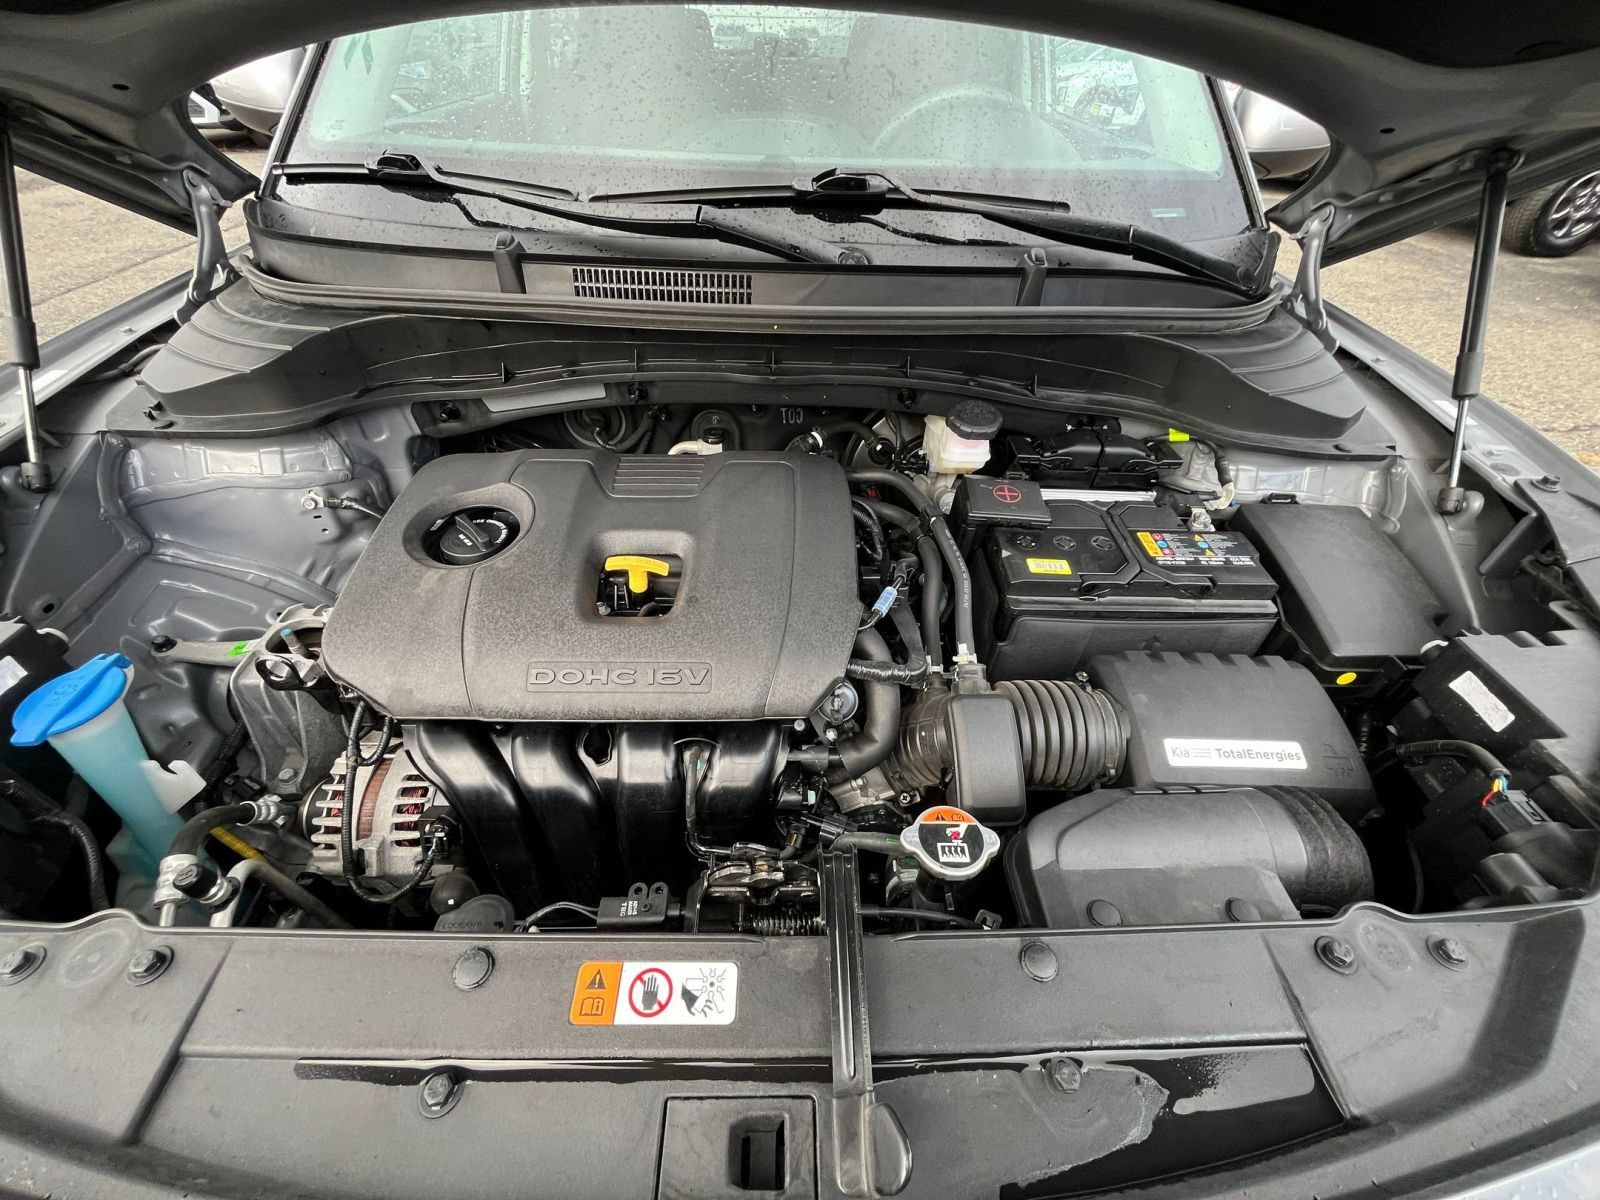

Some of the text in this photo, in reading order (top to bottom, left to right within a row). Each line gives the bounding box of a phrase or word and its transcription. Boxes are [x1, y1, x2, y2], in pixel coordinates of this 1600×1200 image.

[529, 668, 710, 685] DOHC 16V
[1170, 747, 1302, 762] Kia TotalEnergies
